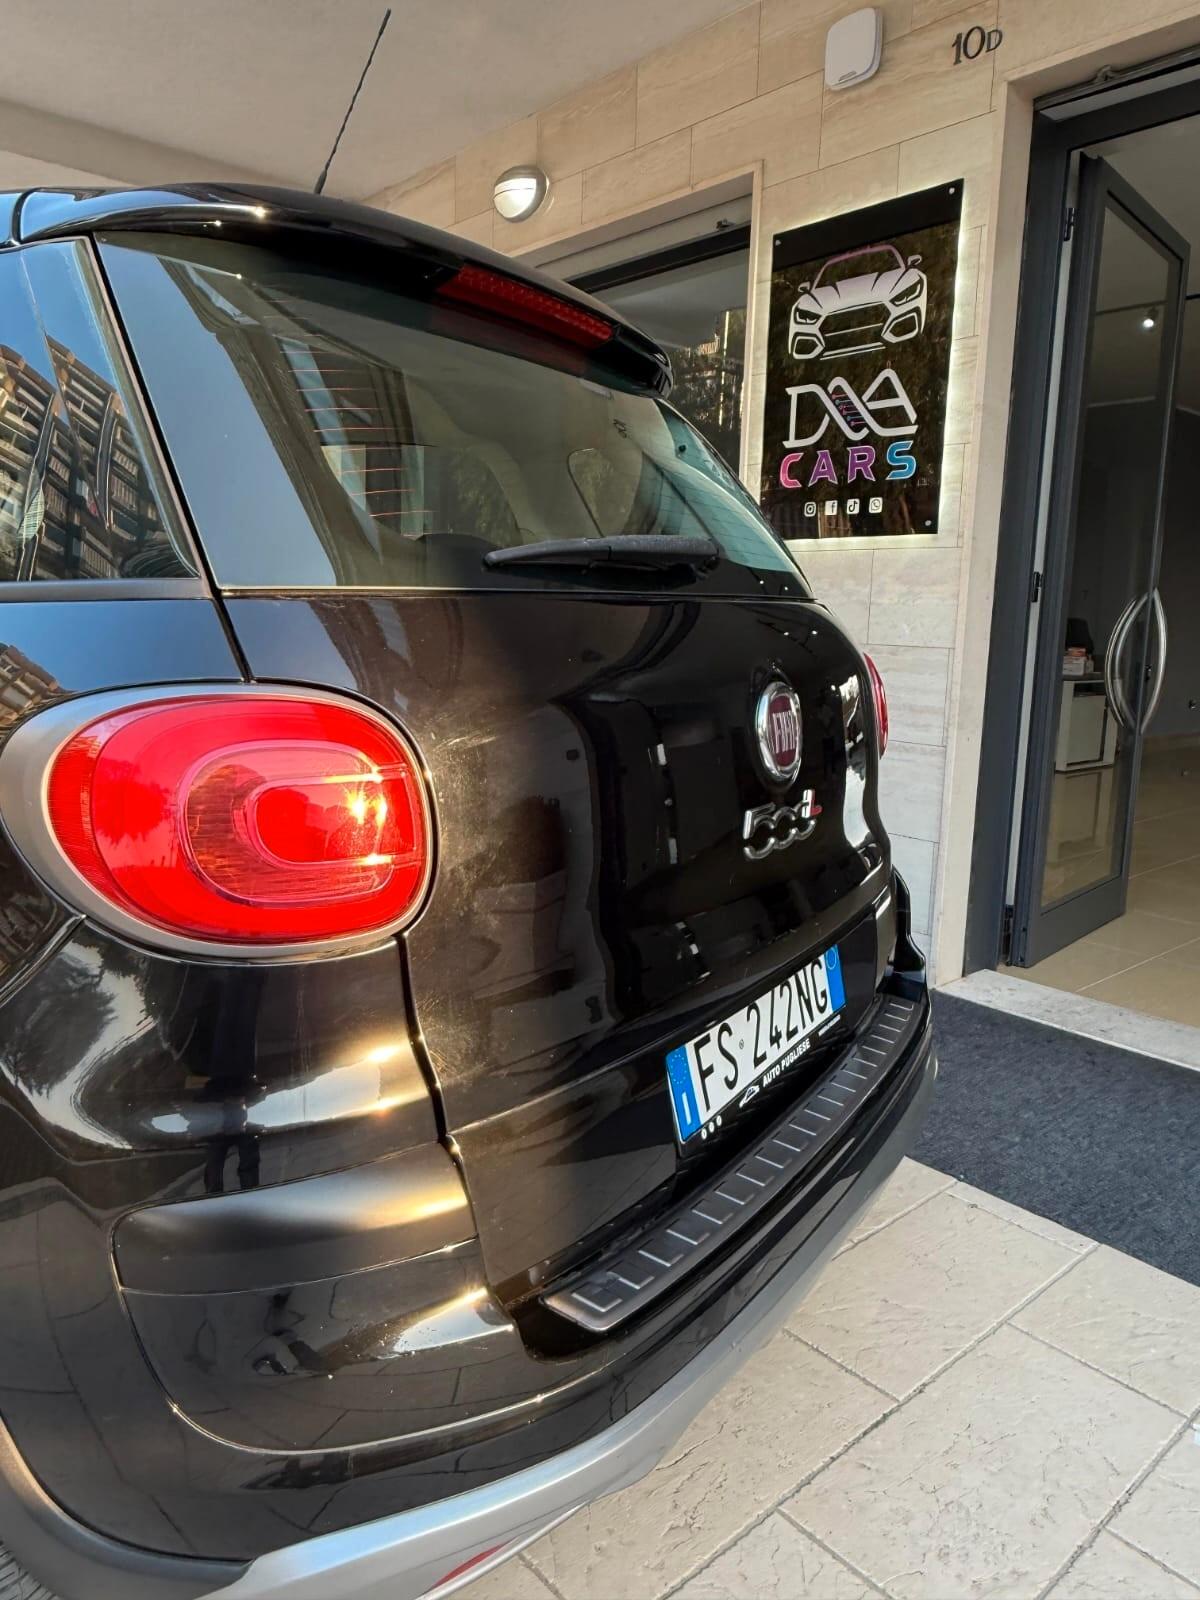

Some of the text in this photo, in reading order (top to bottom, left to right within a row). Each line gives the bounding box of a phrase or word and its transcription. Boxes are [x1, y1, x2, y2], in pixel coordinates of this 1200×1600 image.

[951, 26, 1003, 65] 10D
[782, 368, 918, 448] DNA
[780, 440, 917, 489] CARS
[693, 1022, 739, 1112] FS
[746, 959, 828, 1069] 242NG
[762, 1037, 811, 1088] AUTO PUGLIESE
